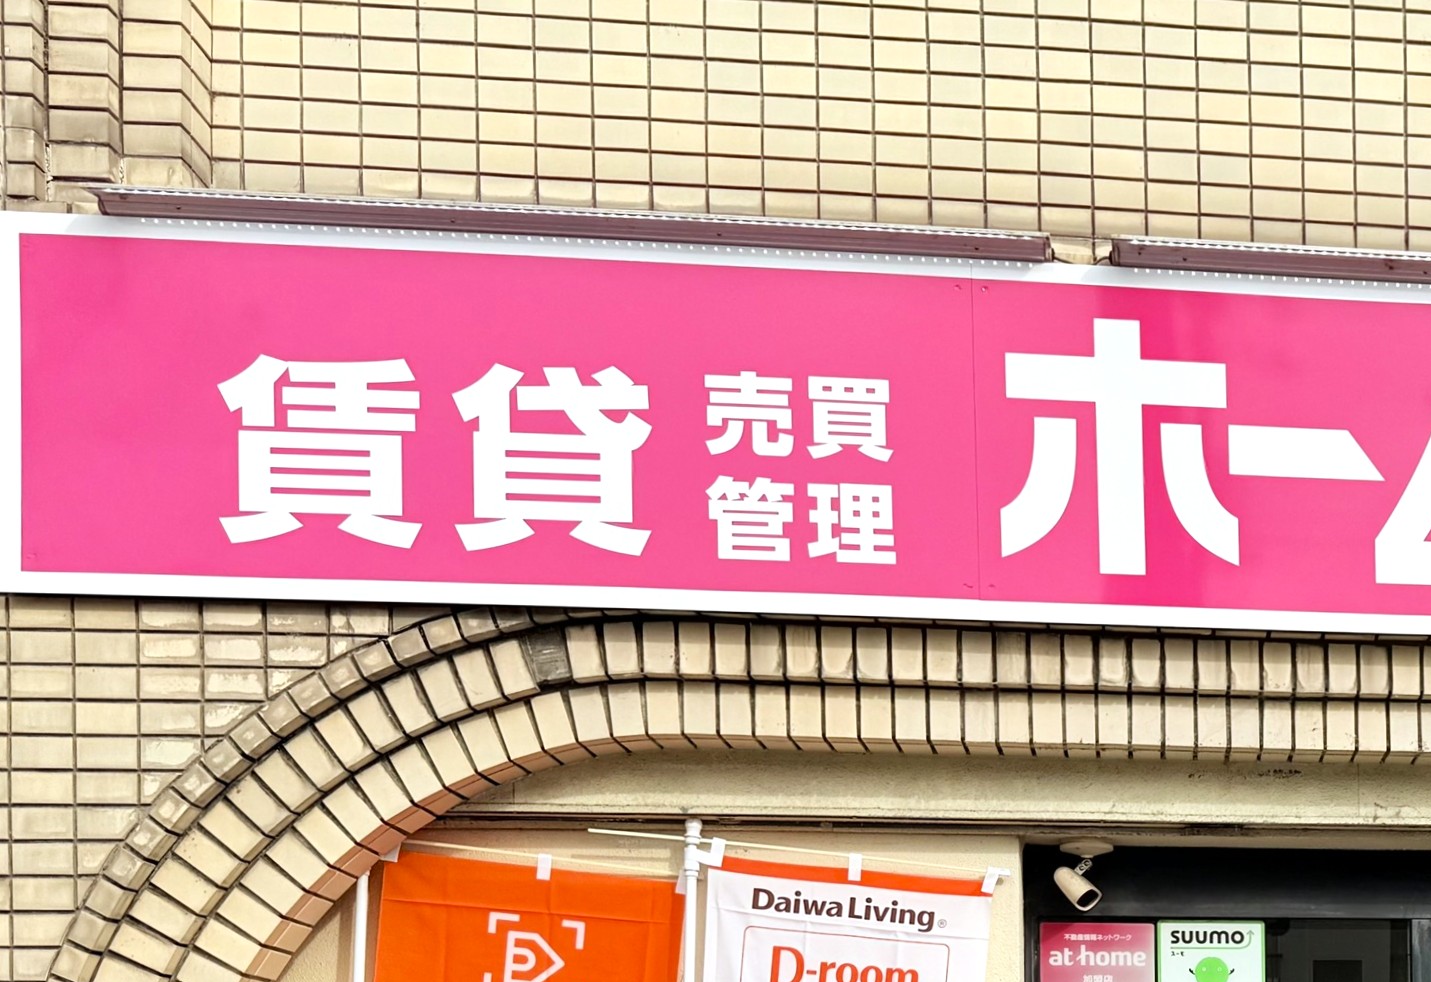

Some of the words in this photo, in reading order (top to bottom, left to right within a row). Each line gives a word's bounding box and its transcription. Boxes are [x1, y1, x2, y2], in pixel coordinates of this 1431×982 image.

[216, 354, 653, 557] 賃貸
[703, 370, 894, 462] 売買
[705, 475, 897, 566] 管理
[751, 887, 843, 918] Daiwa
[847, 896, 935, 933] Living
[1049, 948, 1074, 967] at
[1075, 944, 1146, 967] home
